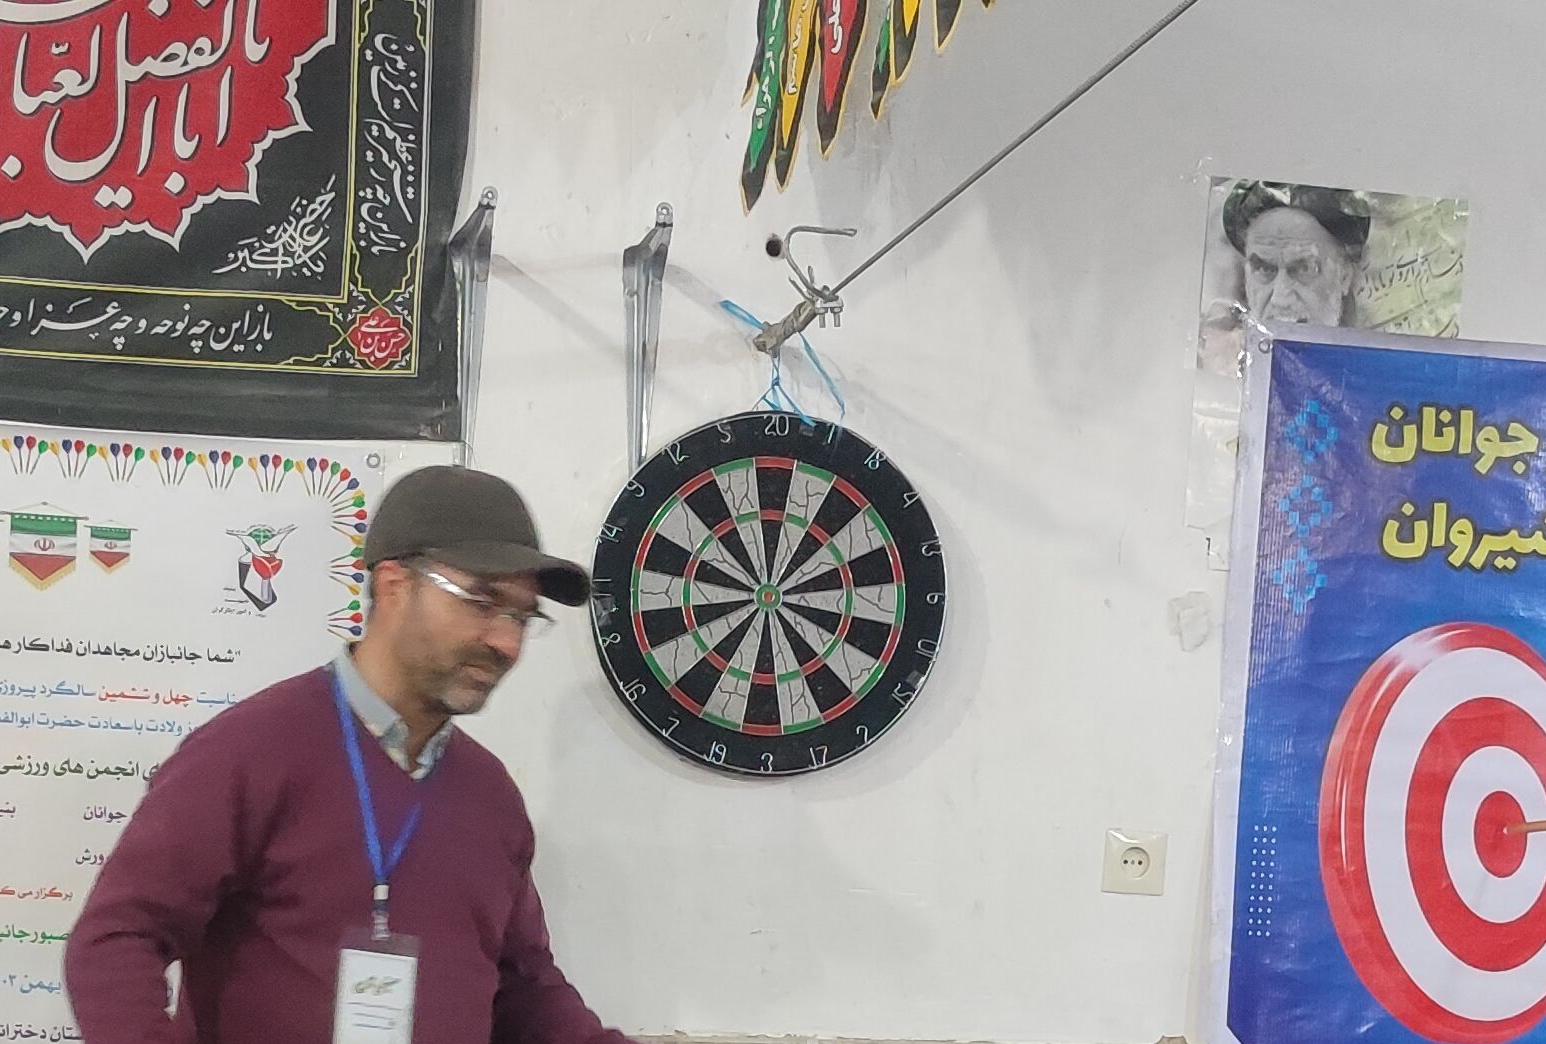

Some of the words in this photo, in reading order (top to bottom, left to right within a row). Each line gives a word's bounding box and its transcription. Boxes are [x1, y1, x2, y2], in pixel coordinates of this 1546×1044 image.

[135, 318, 146, 335] و
[150, 303, 190, 337] نوحه
[763, 414, 790, 437] 20
[1371, 406, 1539, 475] جوانان
[662, 442, 691, 465] 12
[864, 446, 885, 470] 18
[13, 634, 73, 654] فداکار
[75, 640, 141, 662] مجاهدان
[142, 645, 202, 665] جانبازان
[40, 680, 97, 697] سالگرد
[162, 688, 193, 708] چهل
[36, 713, 86, 729] حضرت
[145, 719, 183, 736] ولادت
[704, 740, 728, 765] 19
[808, 745, 829, 768] 17
[53, 758, 84, 777] های
[86, 760, 139, 781] انجمن
[760, 753, 773, 773] 3
[83, 805, 127, 823] جوانان
[19, 974, 62, 994] بهمن
